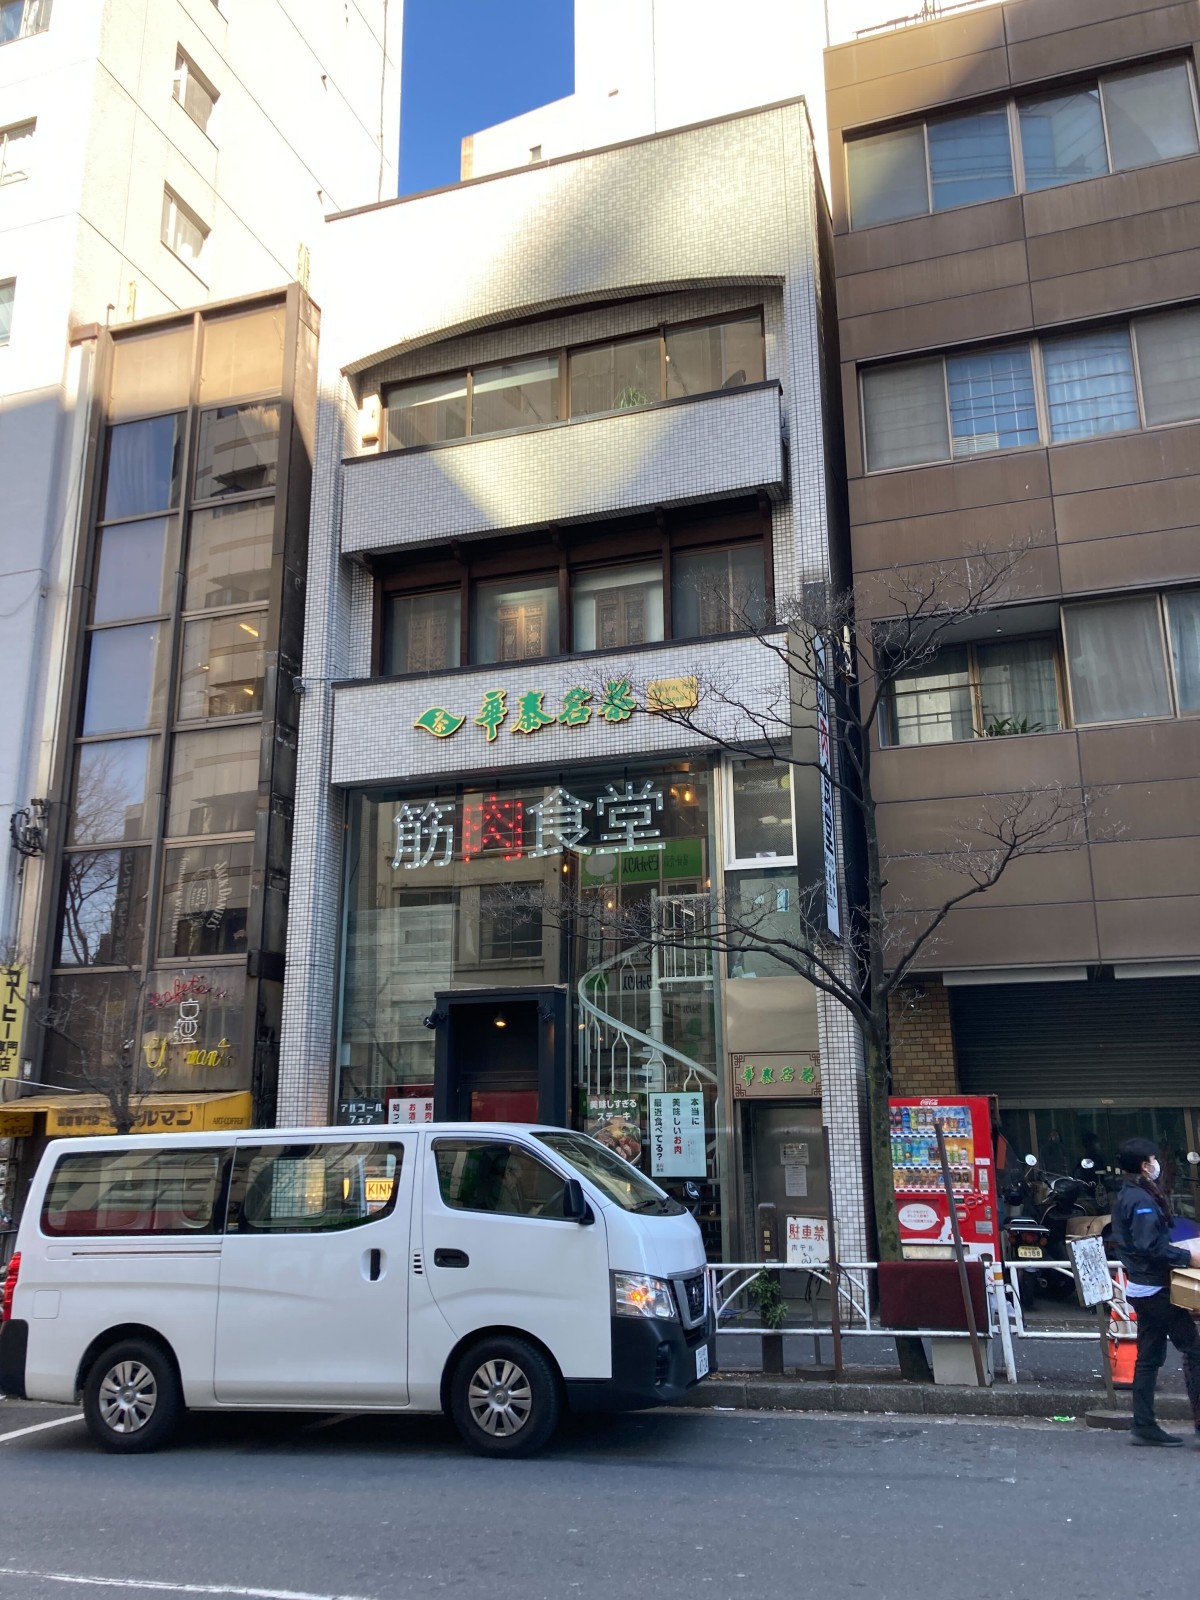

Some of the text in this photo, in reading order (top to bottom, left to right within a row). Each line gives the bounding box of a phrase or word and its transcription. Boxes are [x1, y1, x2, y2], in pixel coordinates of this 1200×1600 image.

[473, 679, 638, 742] 華泰名茶
[392, 780, 667, 871] 筋肉食堂
[741, 1065, 815, 1087] 華泰名茶
[340, 1103, 383, 1113] アルコール
[589, 1099, 637, 1110] 美味しすぎる
[690, 1098, 700, 1126] 本当に
[349, 1115, 374, 1124] フェア
[597, 1112, 631, 1121] ステーキ
[672, 1098, 682, 1155] 美味しいお肉
[788, 1223, 827, 1241] 駐車禁
[791, 1244, 814, 1253] ホテル
